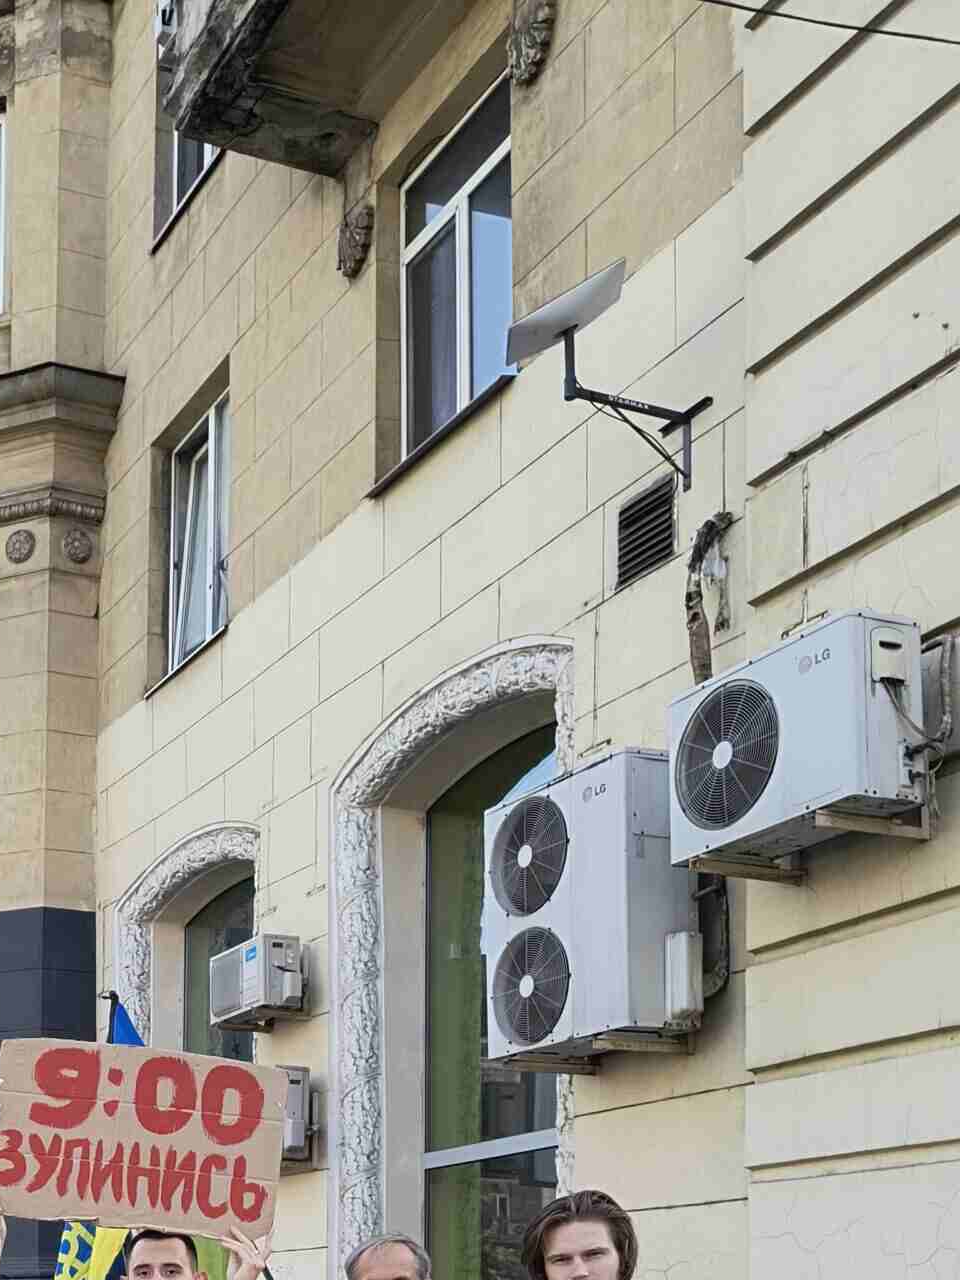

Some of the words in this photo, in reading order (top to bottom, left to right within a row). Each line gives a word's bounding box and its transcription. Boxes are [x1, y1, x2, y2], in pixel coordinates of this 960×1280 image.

[814, 647, 831, 665] LG
[594, 783, 607, 797] LG
[29, 1048, 265, 1146] 9:00
